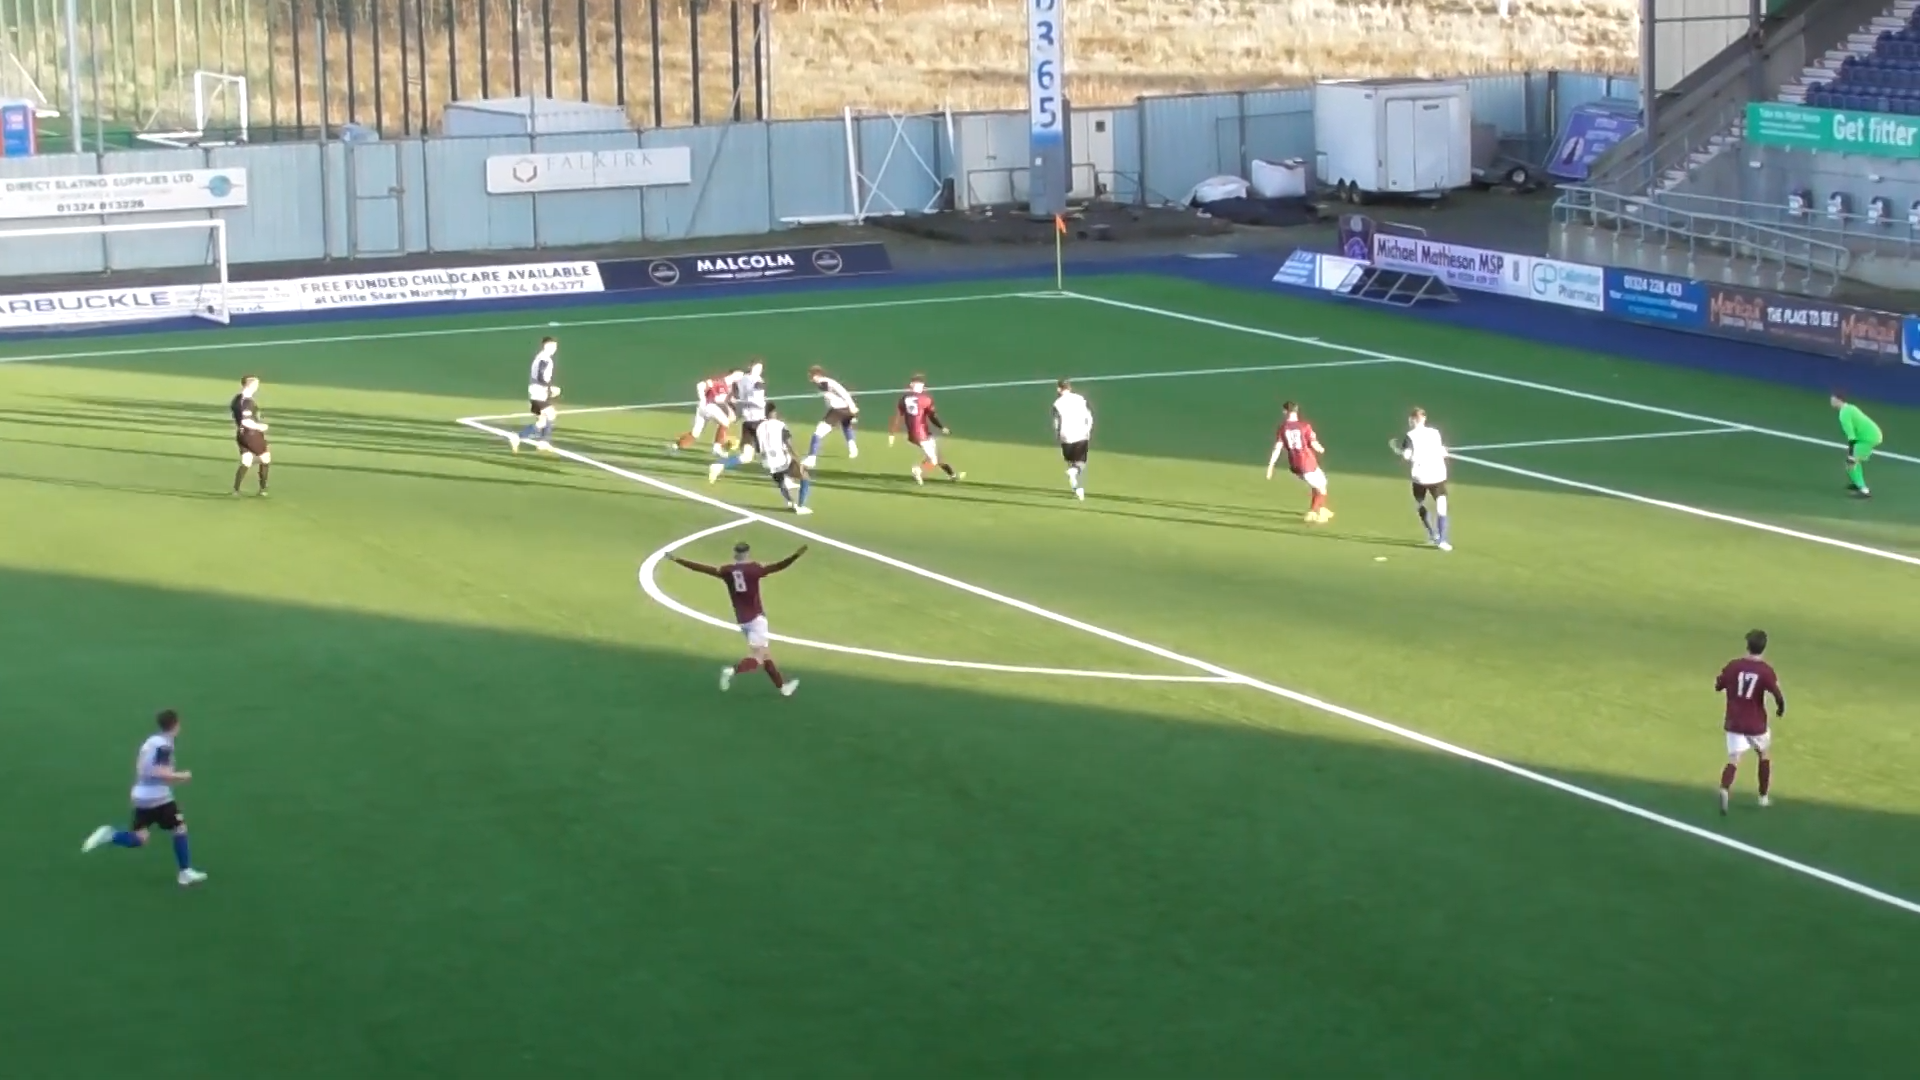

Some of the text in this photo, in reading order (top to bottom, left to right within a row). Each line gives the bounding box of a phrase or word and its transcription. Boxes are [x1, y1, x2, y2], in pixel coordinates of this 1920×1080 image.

[1833, 114, 1918, 147] Get fitter
[546, 153, 654, 172] FALKIRK
[5, 173, 194, 192] DIRECT SLATING SUPPLIES LTD
[57, 202, 95, 213] 01324
[697, 253, 796, 272] MALCOLM
[1376, 238, 1419, 262] Michael
[1421, 245, 1476, 270] Matheson
[1479, 253, 1504, 275] MSP
[300, 265, 592, 294] FREE FUNDED CHILDCARE AVAILABLE
[331, 292, 367, 304] Little
[370, 290, 408, 302] Stars
[410, 287, 467, 301] Nursery
[482, 284, 526, 296] 01324
[1559, 283, 1601, 307] Pharmacy
[1767, 307, 1782, 322] THE
[1784, 308, 1807, 325] PLACE
[731, 570, 747, 592] 8
[1737, 671, 1759, 699] 17
